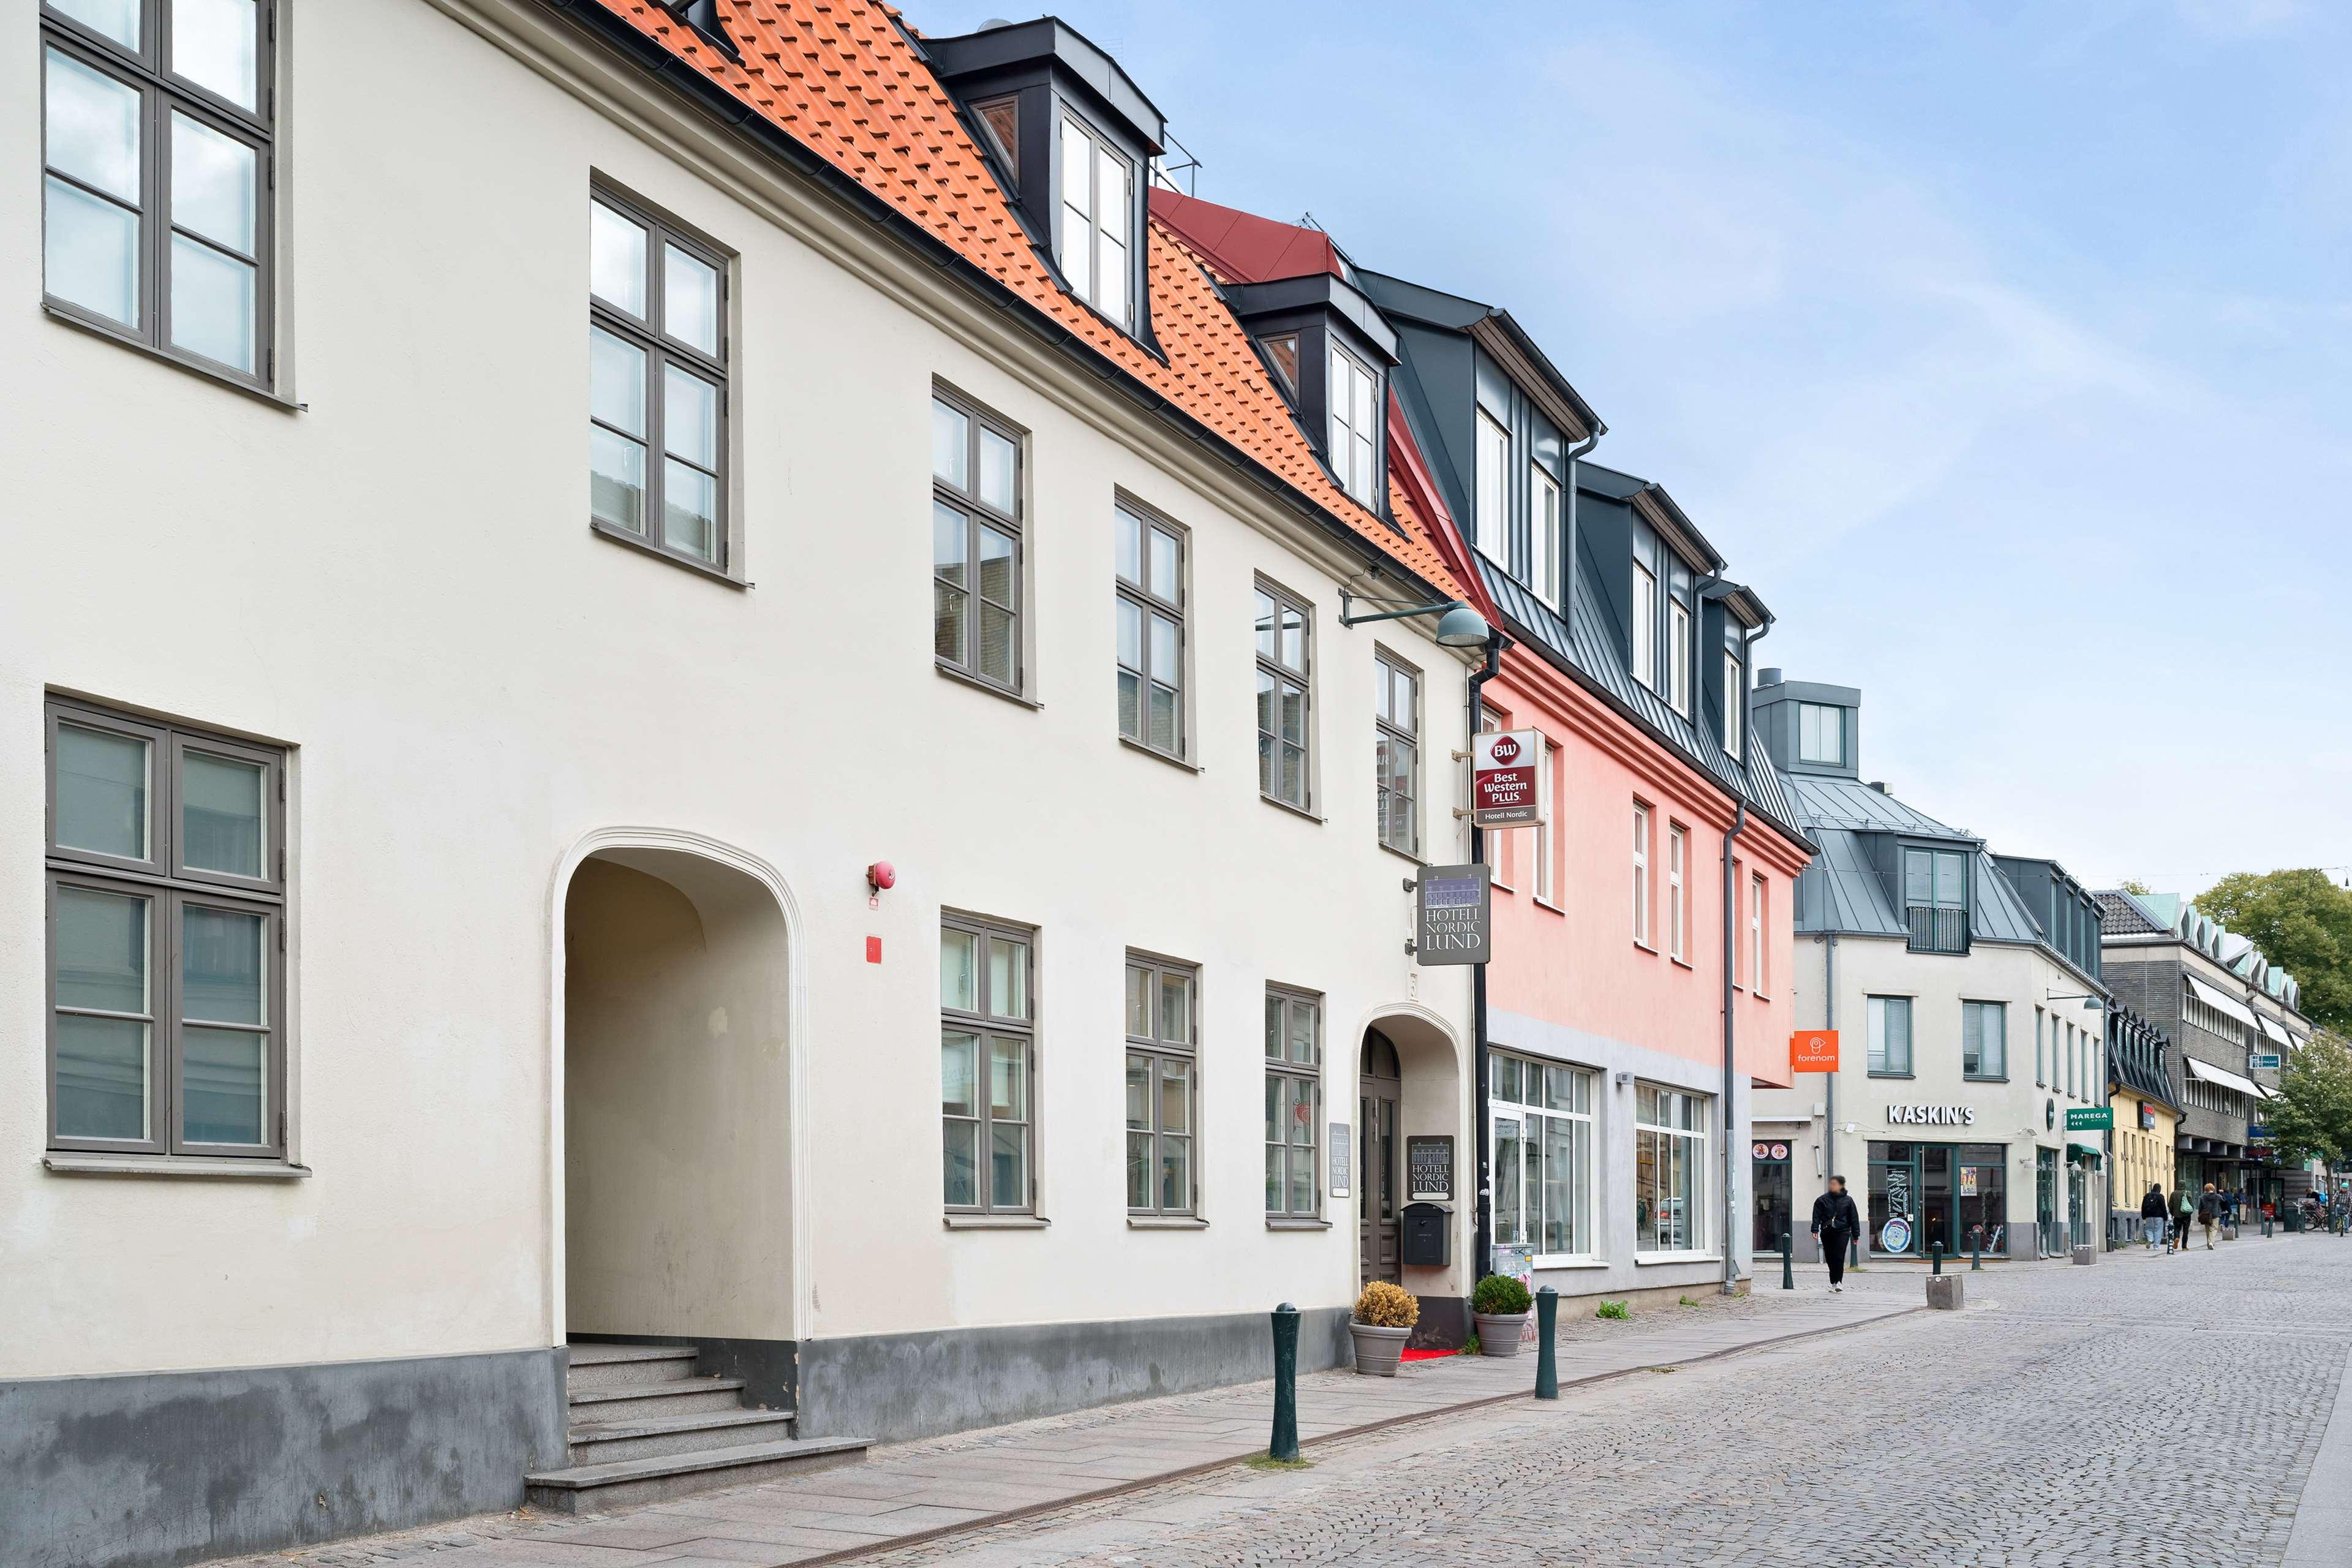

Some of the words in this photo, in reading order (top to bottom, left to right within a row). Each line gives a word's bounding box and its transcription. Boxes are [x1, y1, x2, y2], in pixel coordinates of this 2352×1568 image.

[1494, 744, 1517, 757] BW
[1494, 773, 1518, 783] Best
[1484, 782, 1527, 793] Western
[1425, 908, 1481, 922] HOTELL
[1425, 921, 1480, 933] NORDIC
[1426, 933, 1480, 951] LUND
[1887, 1105, 1975, 1125] KASKIN'S
[1332, 1156, 1348, 1166] HOTELL
[1332, 1166, 1349, 1175] NORDIC
[1412, 1164, 1449, 1173] HOTELL
[1332, 1175, 1349, 1188] LUND
[1412, 1173, 1449, 1182] NORDIC
[1412, 1181, 1449, 1192] LUND
